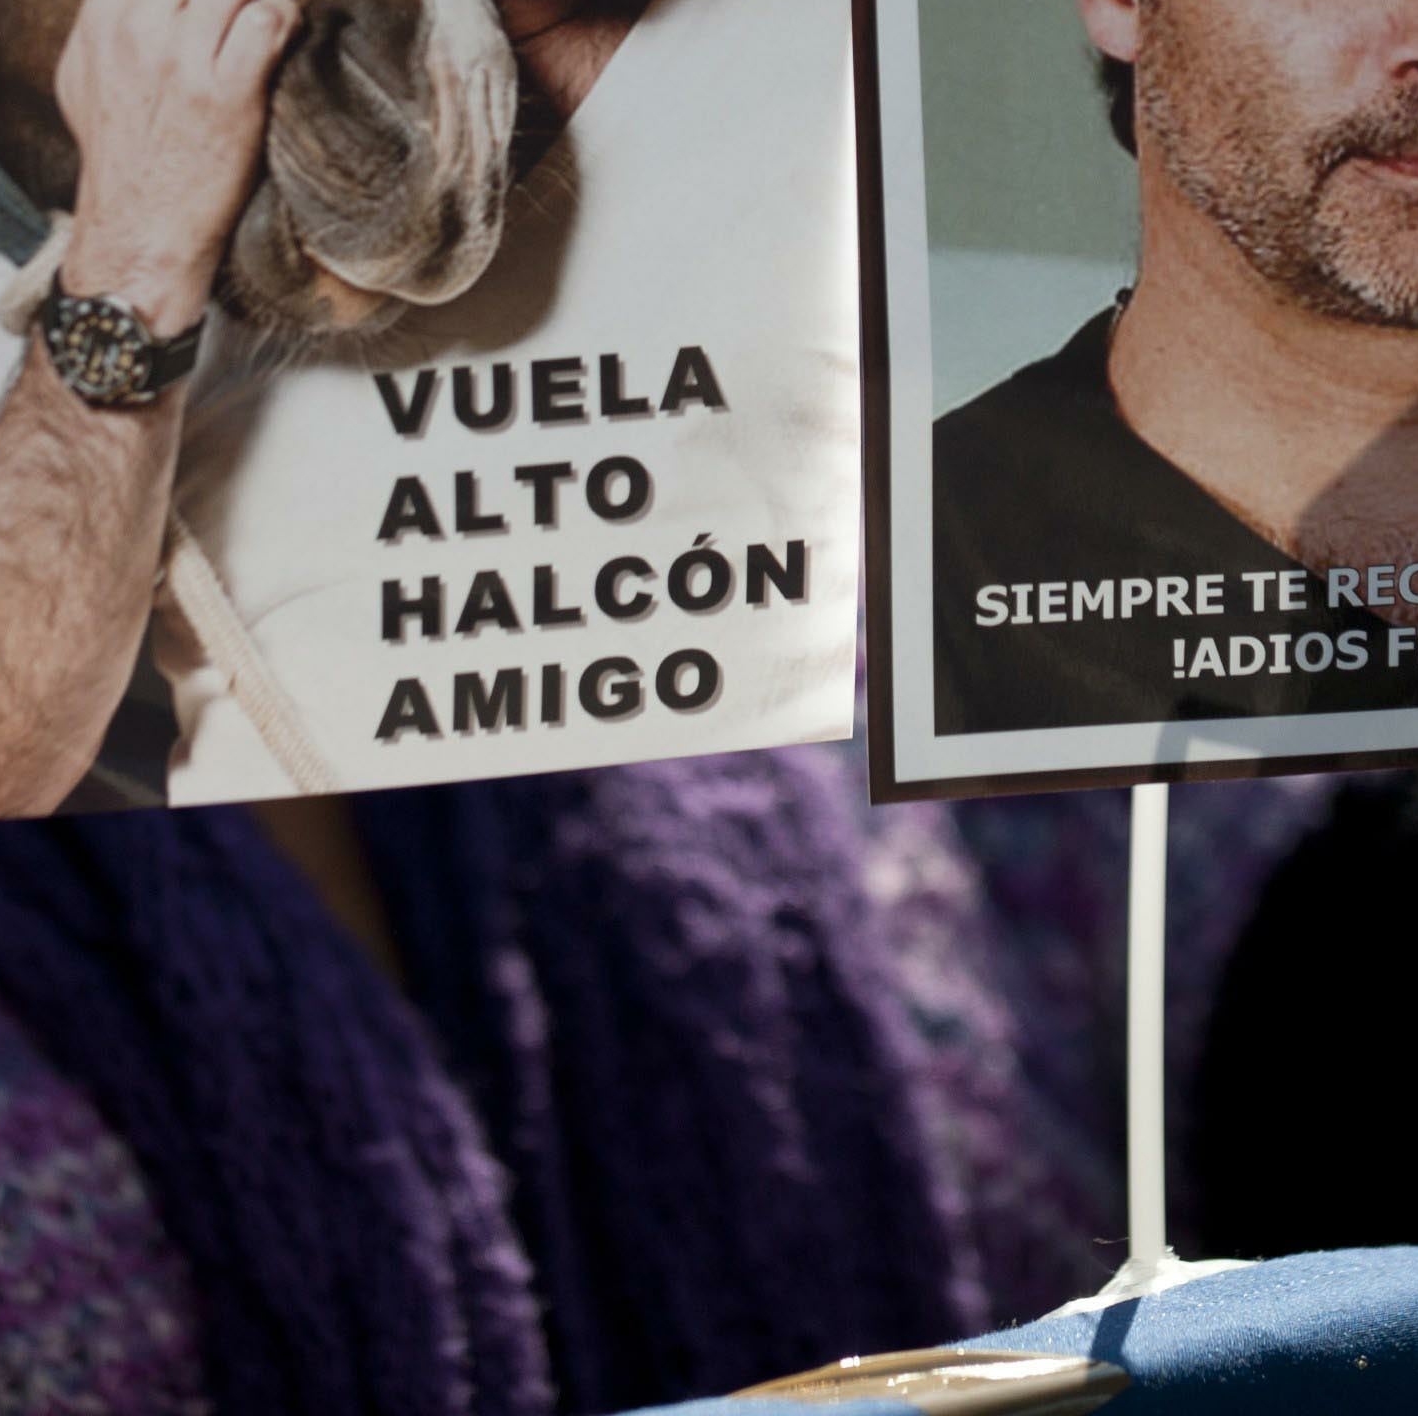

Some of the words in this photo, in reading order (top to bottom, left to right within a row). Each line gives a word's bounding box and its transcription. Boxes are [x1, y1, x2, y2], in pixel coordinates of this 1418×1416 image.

[374, 346, 728, 439] VUELA
[377, 455, 654, 541] ALTO
[380, 532, 809, 644] HALCÓN
[975, 573, 1226, 627] SIEMPRE
[1241, 569, 1308, 613] TE
[374, 647, 723, 743] AMIGO
